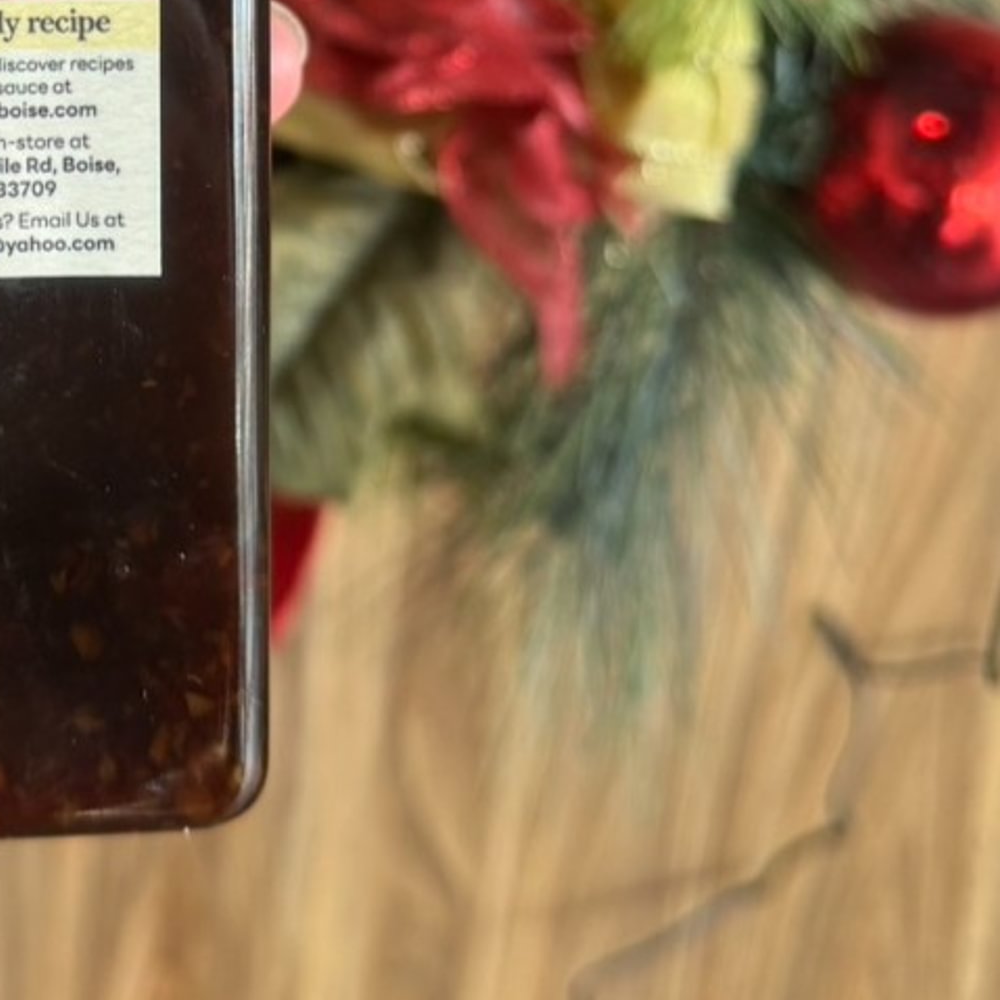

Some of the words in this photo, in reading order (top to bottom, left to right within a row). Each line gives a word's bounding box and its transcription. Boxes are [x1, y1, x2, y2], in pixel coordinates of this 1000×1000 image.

[28, 9, 111, 41] recipe
[70, 56, 134, 74] recipes
[52, 79, 72, 94] at
[69, 134, 90, 149] at
[26, 157, 57, 175] Rd,
[63, 157, 120, 175] Boise,
[18, 212, 71, 230] Email
[75, 212, 99, 228] Us
[104, 212, 124, 228] at
